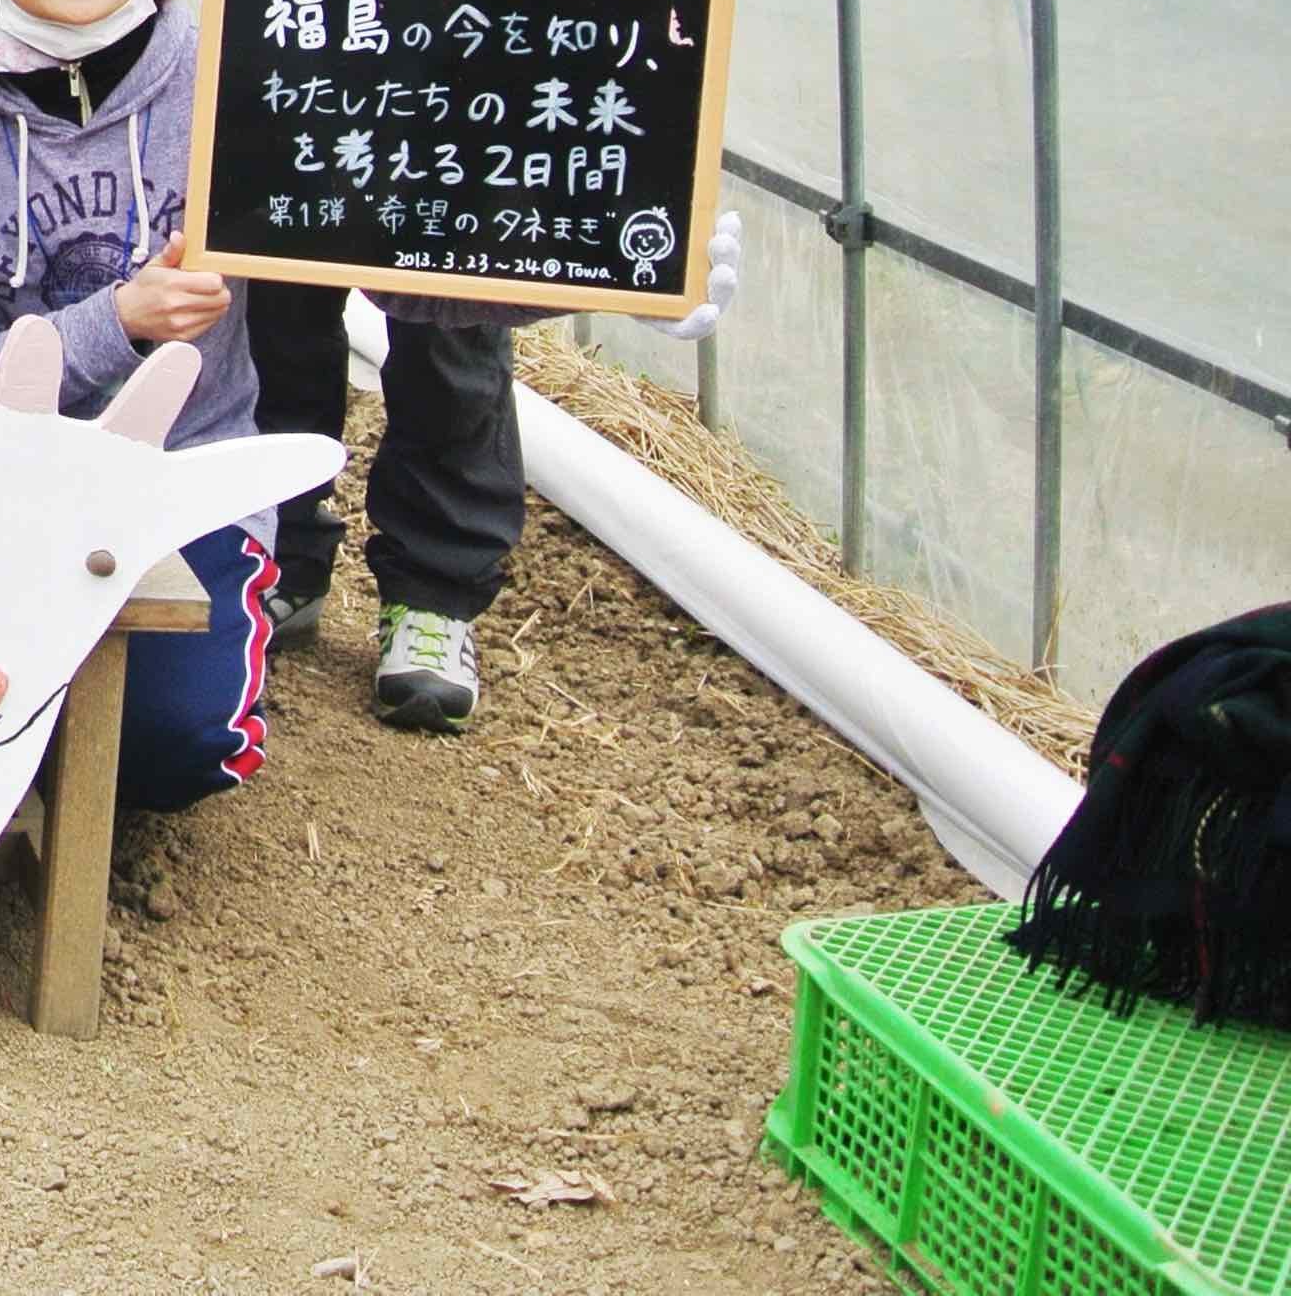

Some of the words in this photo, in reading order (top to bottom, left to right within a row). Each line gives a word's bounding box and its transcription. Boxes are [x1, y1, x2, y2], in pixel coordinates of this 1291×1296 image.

[262, 69, 646, 135] わたしたちの未来
[293, 129, 627, 196] を考える2日間
